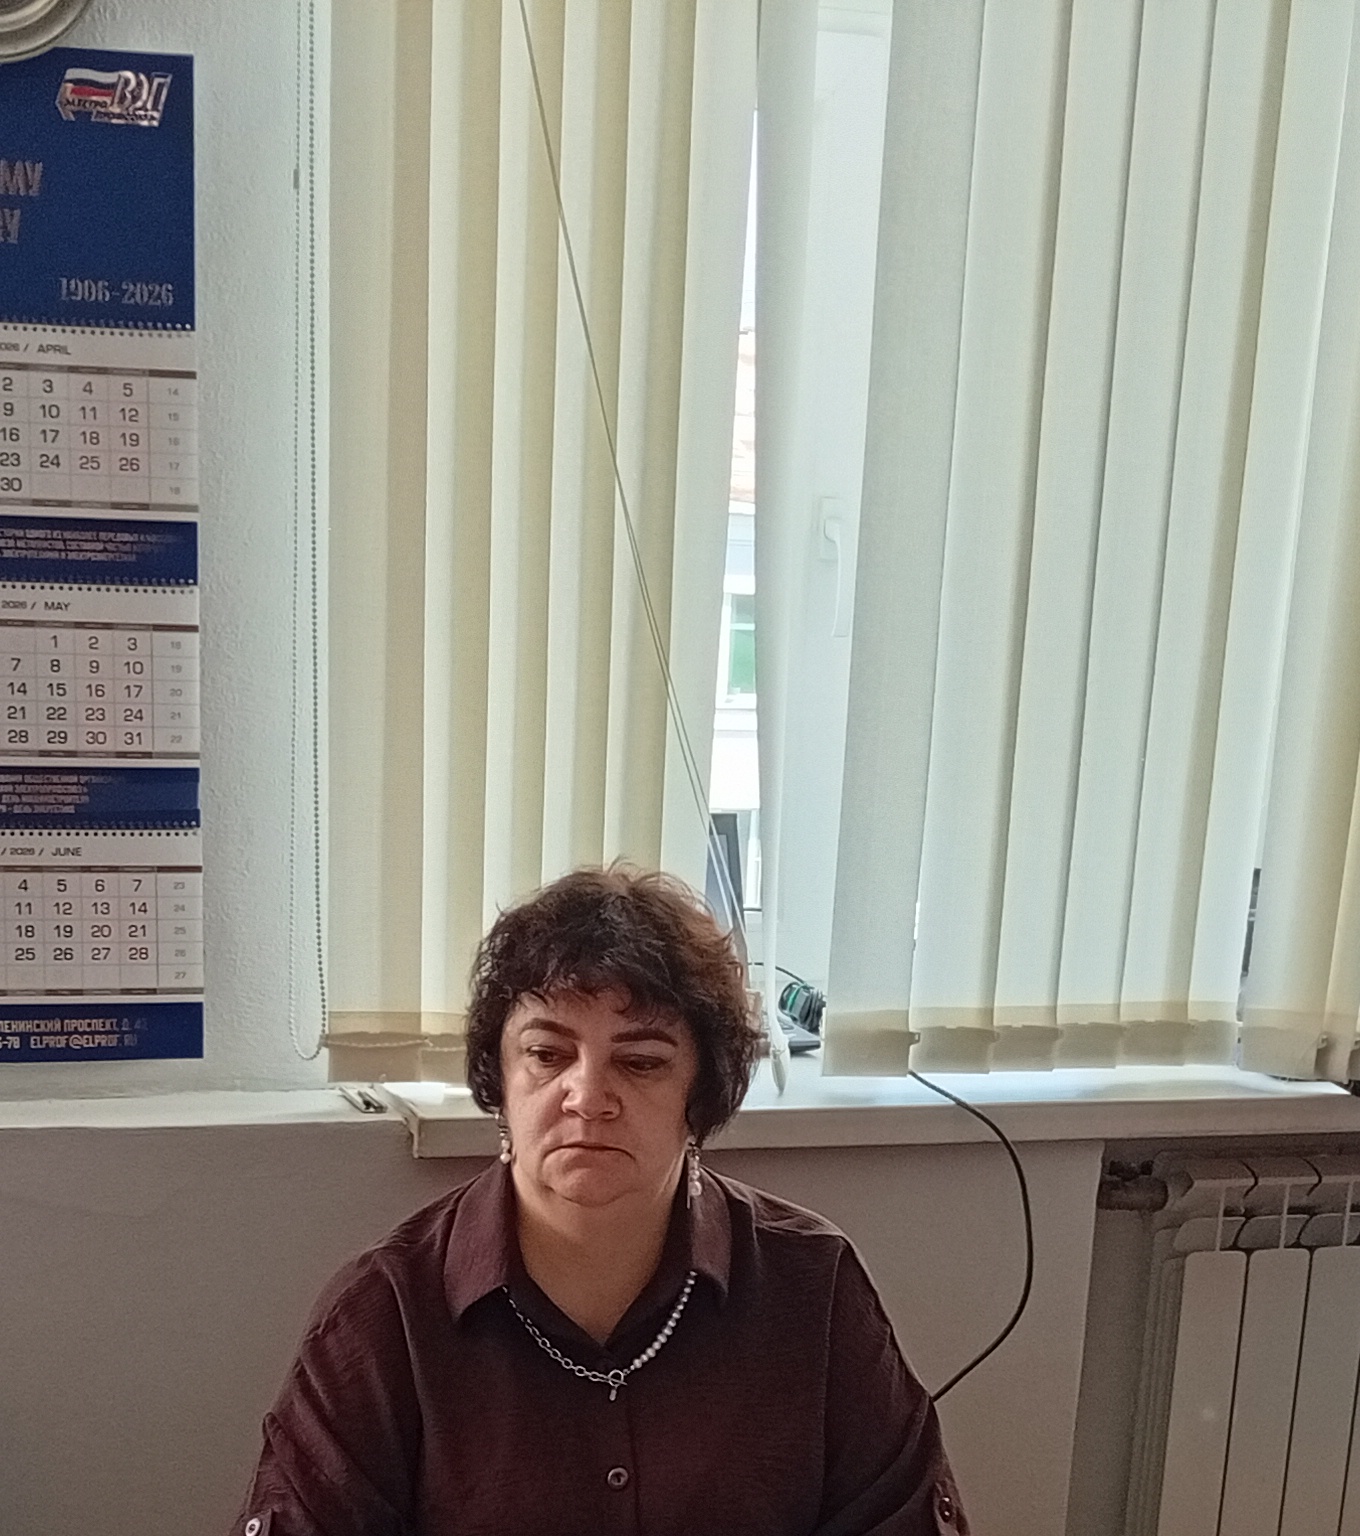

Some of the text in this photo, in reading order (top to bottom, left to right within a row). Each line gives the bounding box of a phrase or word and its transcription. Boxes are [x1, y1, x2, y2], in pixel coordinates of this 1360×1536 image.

[36, 343, 72, 356] APRIL
[1, 376, 14, 392] 2
[42, 378, 54, 394] 3
[82, 381, 94, 396] 4
[122, 382, 134, 398] 5
[2, 401, 15, 417] 9
[39, 403, 61, 419] 10
[79, 405, 98, 421] 11
[119, 407, 140, 423] 12
[0, 426, 21, 443] 16
[39, 428, 60, 444] 17
[80, 430, 101, 446] 18
[119, 432, 140, 448] 19
[39, 453, 61, 469] 24
[78, 455, 101, 471] 25
[118, 456, 141, 473] 26
[0, 476, 23, 493] 30
[43, 600, 71, 611] MAY
[50, 634, 58, 649] 1
[87, 635, 100, 651] 2
[127, 636, 138, 652] 3
[10, 657, 22, 672] 7
[49, 658, 61, 673] 8
[88, 659, 100, 675] 9
[123, 660, 145, 676] 10
[7, 681, 28, 696] 14
[46, 682, 67, 698] 15
[85, 683, 106, 698] 16
[124, 684, 144, 699] 17
[6, 705, 27, 720] 21
[45, 706, 68, 721] 22
[84, 707, 106, 722] 23
[123, 707, 144, 723] 24
[7, 729, 30, 744] 28
[46, 729, 68, 745] 29
[85, 730, 108, 746] 30
[123, 731, 143, 746] 31
[51, 847, 83, 857] JUNE
[17, 878, 29, 892] 4
[56, 878, 68, 893] 5
[94, 878, 106, 893] 6
[132, 878, 143, 893] 7
[14, 901, 33, 916] 11
[53, 901, 73, 916] 12
[91, 901, 111, 916] 13
[129, 901, 148, 915] 14
[15, 924, 36, 939] 18
[53, 924, 74, 939] 19
[90, 924, 112, 939] 20
[127, 924, 147, 938] 21
[14, 947, 36, 962] 25
[52, 947, 74, 962] 26
[91, 946, 112, 961] 27
[128, 946, 149, 961] 28
